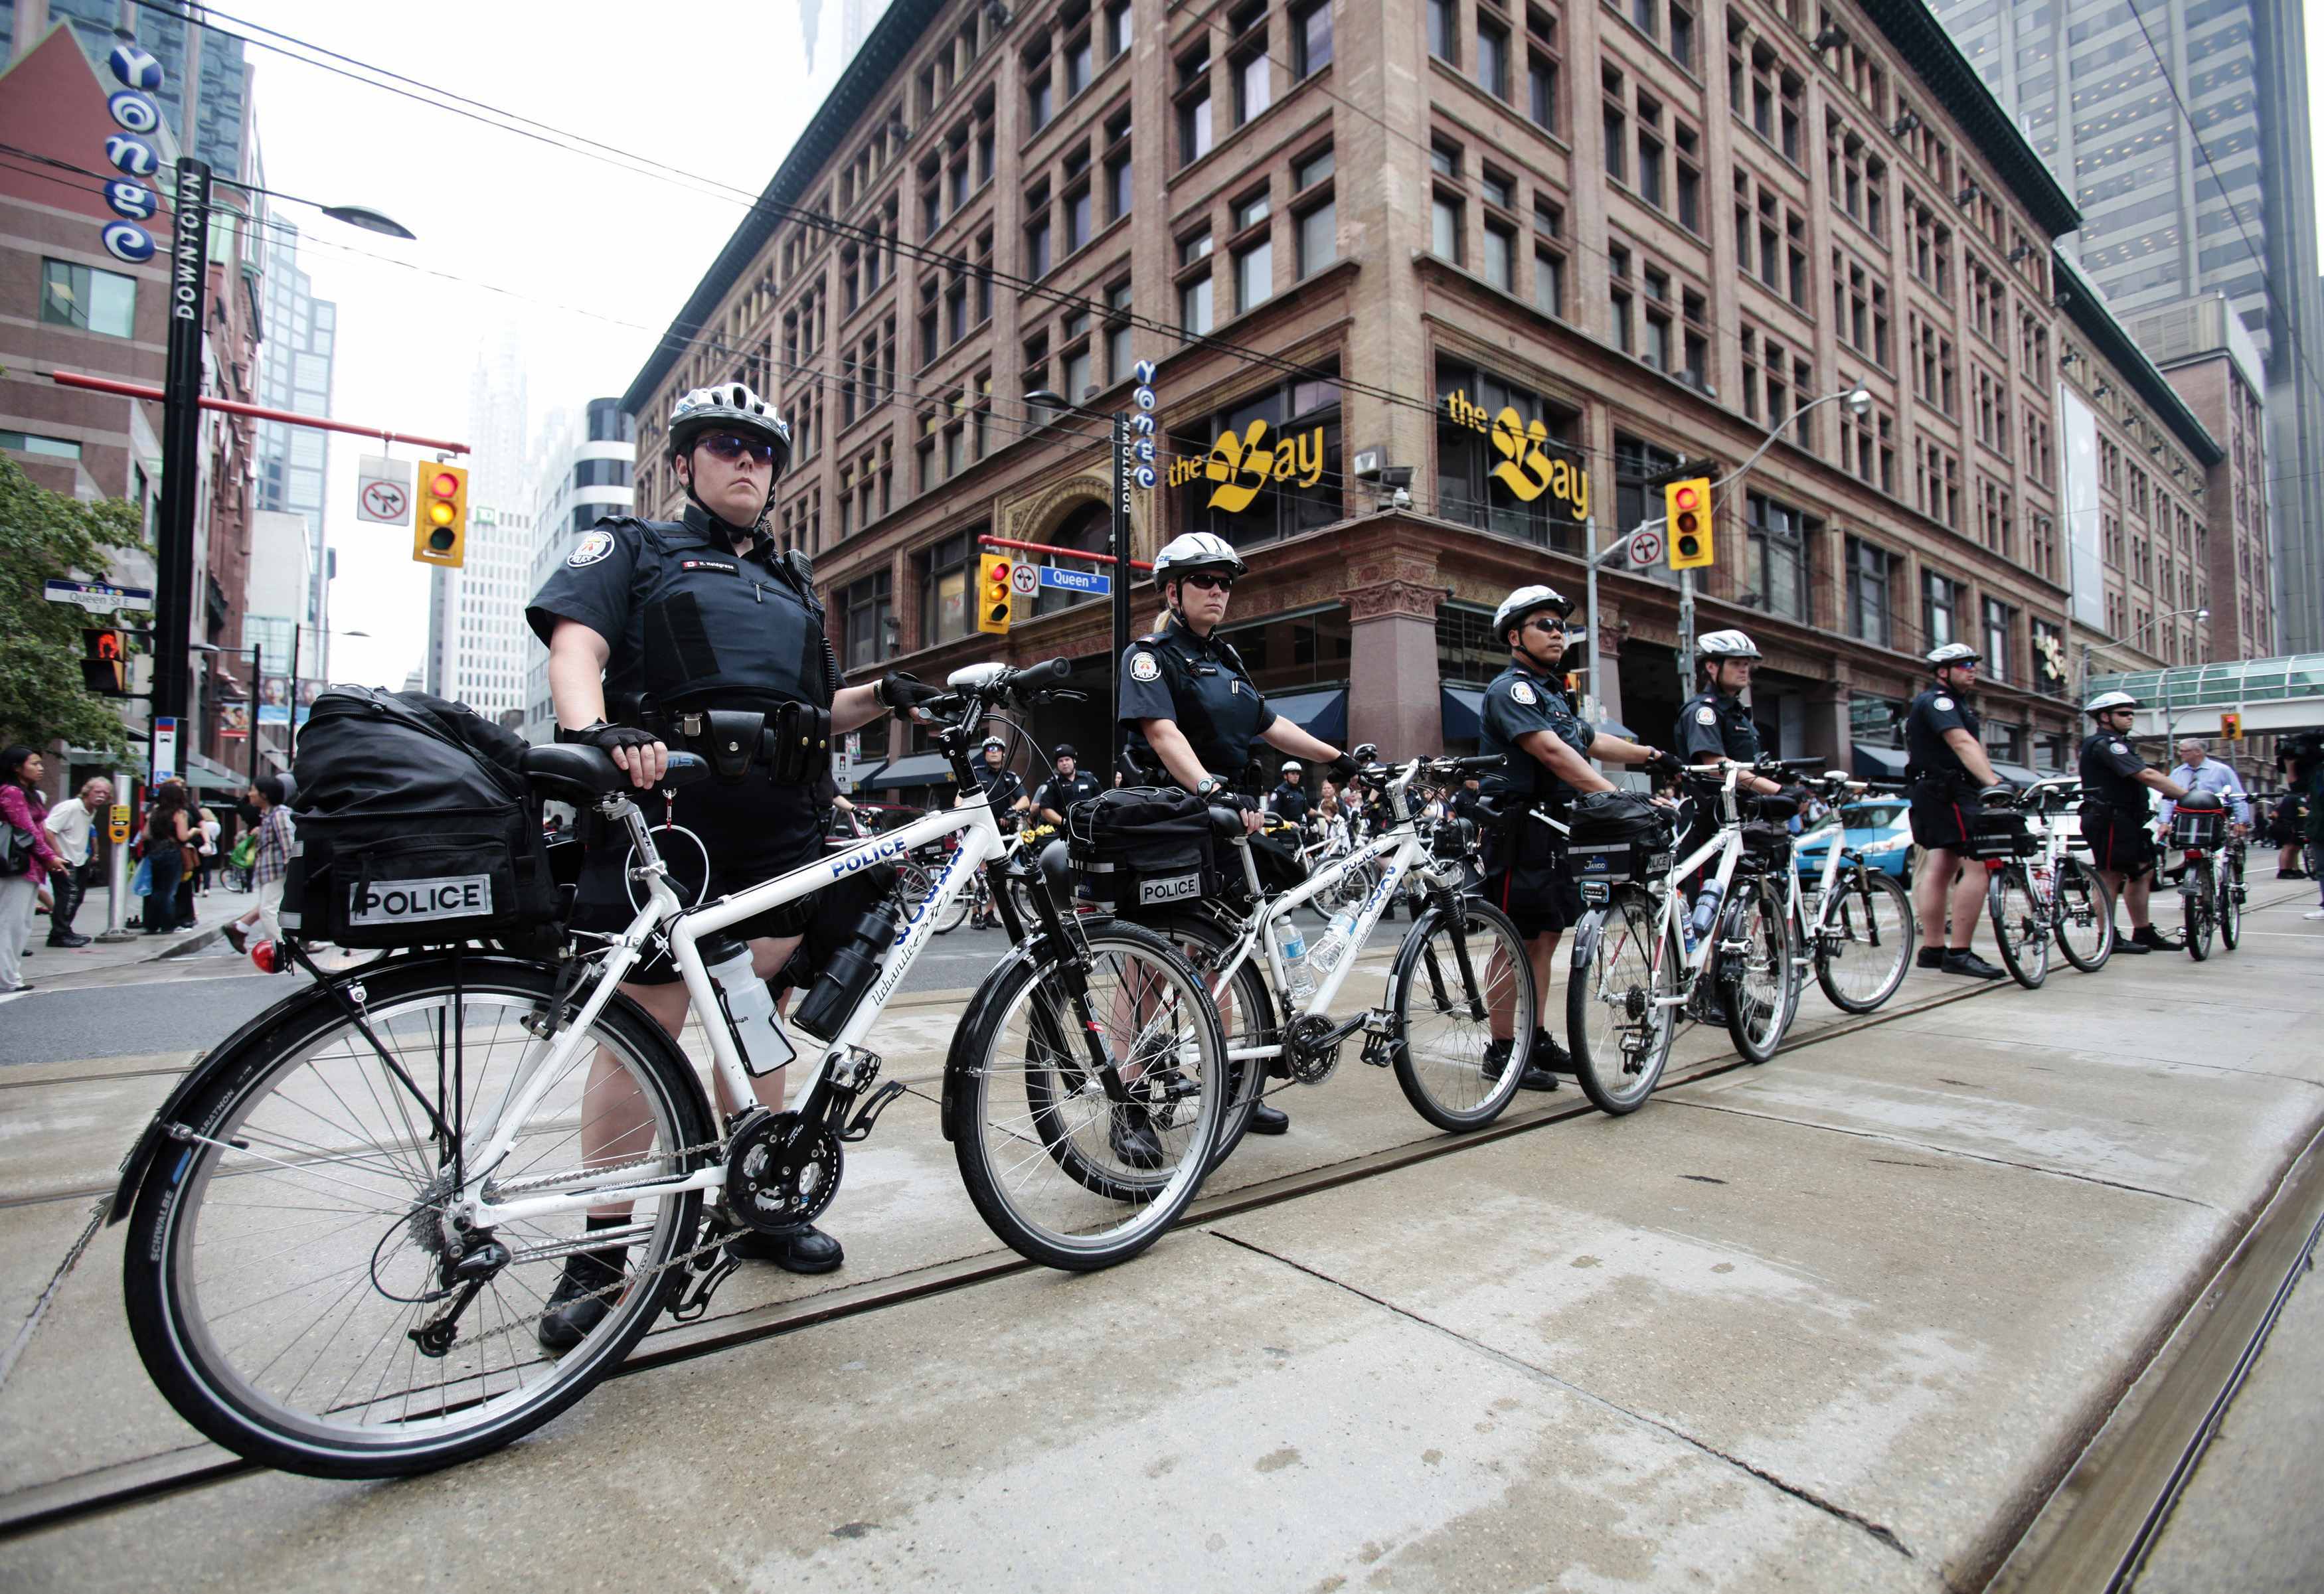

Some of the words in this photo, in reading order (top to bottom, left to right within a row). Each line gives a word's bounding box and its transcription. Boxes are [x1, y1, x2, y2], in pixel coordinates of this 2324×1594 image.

[176, 173, 201, 320] DOWNTOWN
[1122, 422, 1131, 514] DOWNTOWN
[1169, 453, 1202, 488] the
[1204, 419, 1323, 513] Bay
[1446, 389, 1487, 434] the
[1489, 406, 1588, 521] Bay
[1053, 570, 1089, 588] Queen
[69, 592, 107, 604] Queen
[110, 596, 121, 606] St
[124, 598, 130, 607] E
[831, 836, 908, 878] POLICE
[1341, 845, 1380, 874] POLICE
[361, 884, 481, 916] POLICE
[1144, 879, 1196, 900] POLICE
[1165, 950, 1191, 973] SCHWALBE
[200, 1089, 234, 1137] ARATHON
[787, 1124, 804, 1149] ALIVIO
[150, 1188, 175, 1262] SCHWALBE
